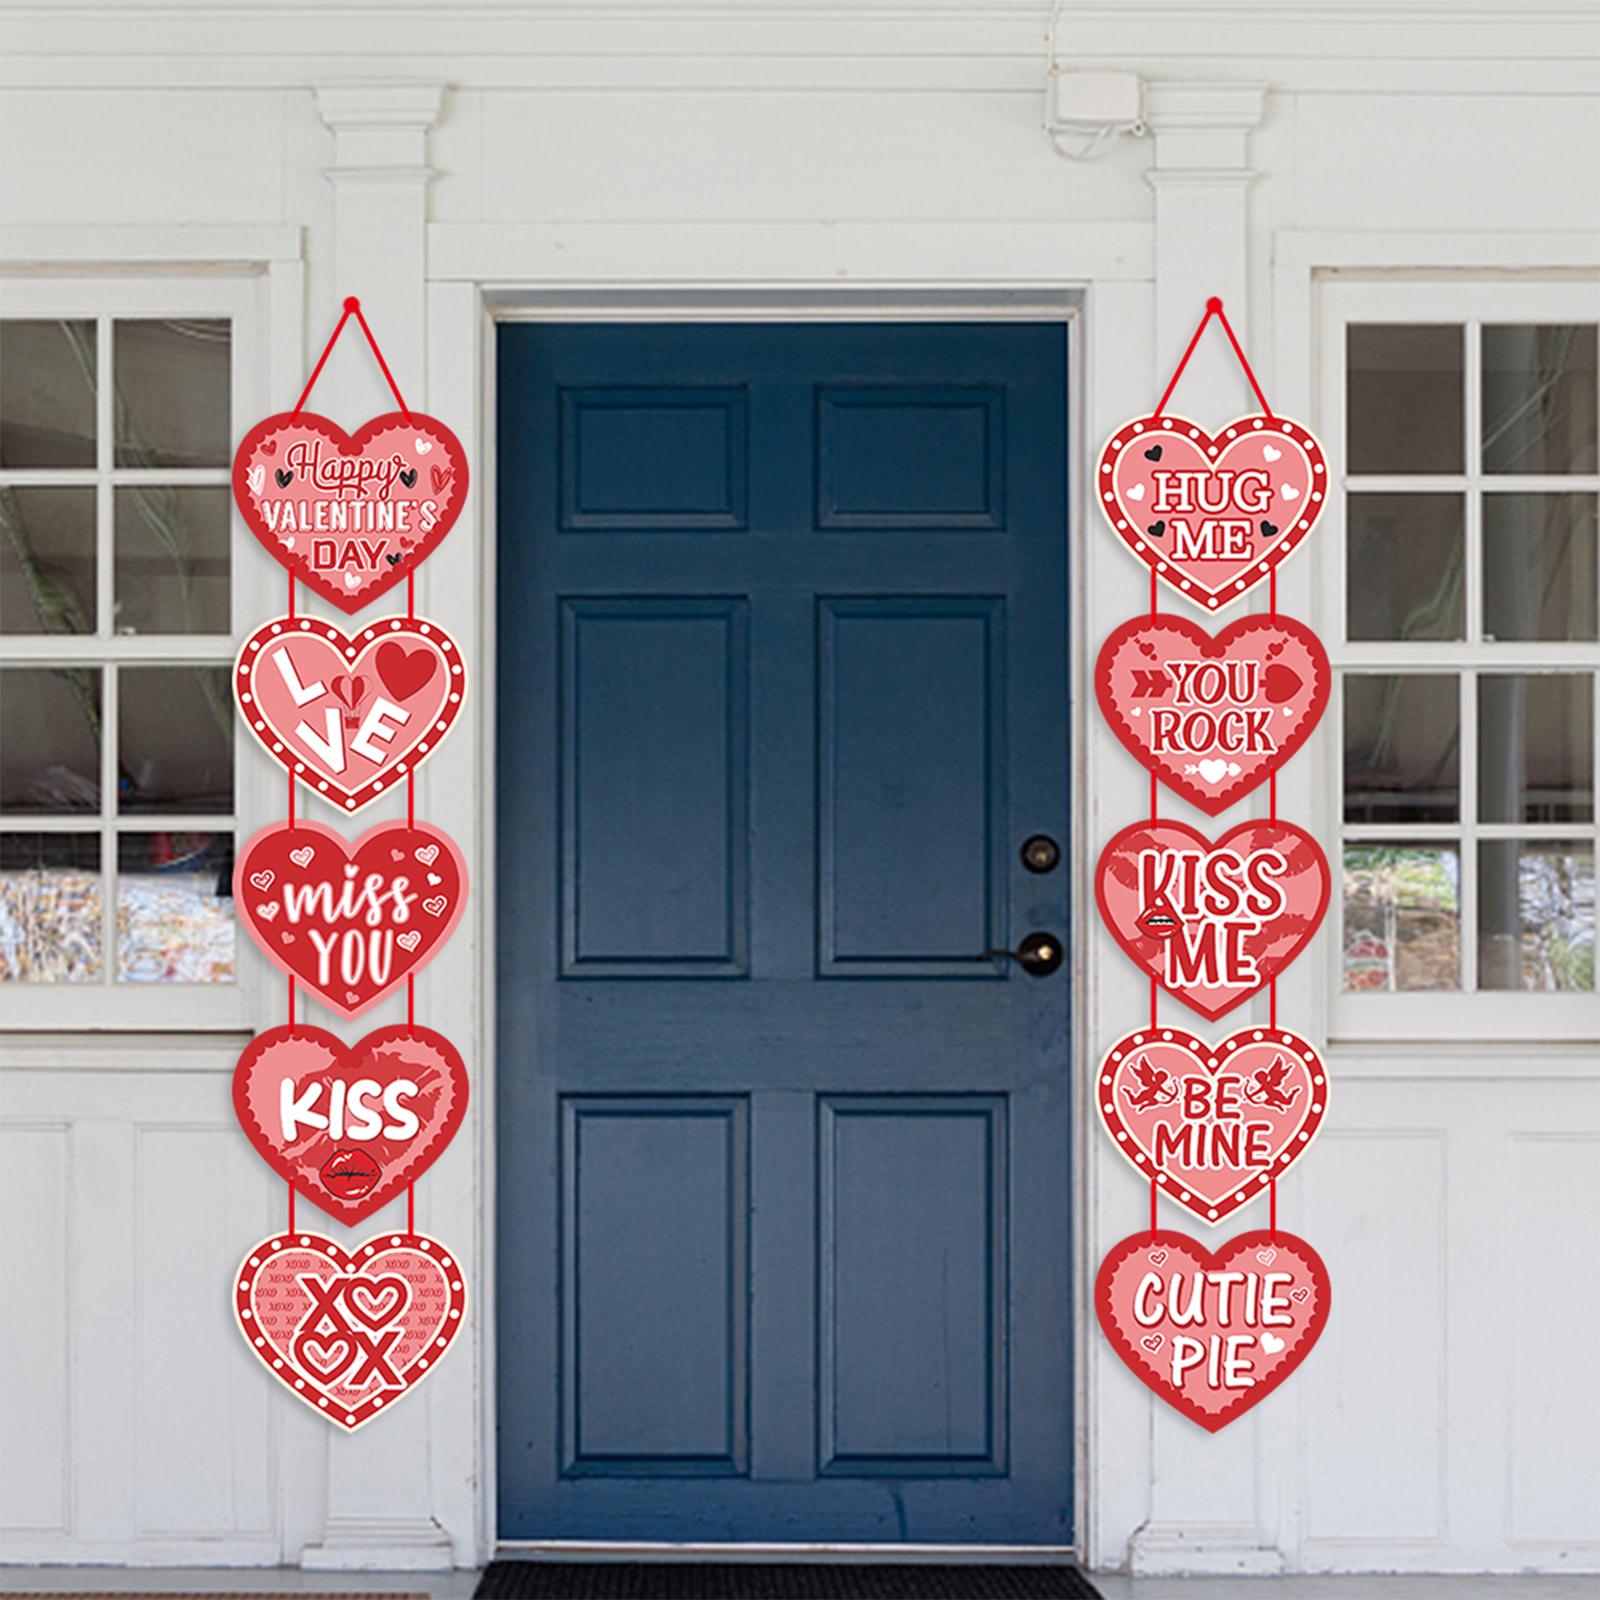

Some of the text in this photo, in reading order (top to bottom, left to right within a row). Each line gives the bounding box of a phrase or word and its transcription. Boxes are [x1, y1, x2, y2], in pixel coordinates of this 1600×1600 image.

[286, 439, 407, 500] Happy
[1151, 468, 1274, 514] HUG
[261, 500, 438, 534] VALENTINE'S
[1169, 517, 1253, 561] ME
[312, 537, 389, 572] DAY
[1165, 661, 1259, 706] YOU
[1149, 708, 1278, 755] ROCK
[283, 863, 418, 927] miss
[1139, 849, 1288, 921] KISS
[308, 928, 393, 986] YOU
[1165, 921, 1261, 988] ME
[280, 1077, 420, 1142] KISS
[1183, 1075, 1242, 1120] BE
[1153, 1122, 1274, 1170] MINE
[1133, 1271, 1295, 1327] CUTIE
[1170, 1334, 1258, 1390] PIE
